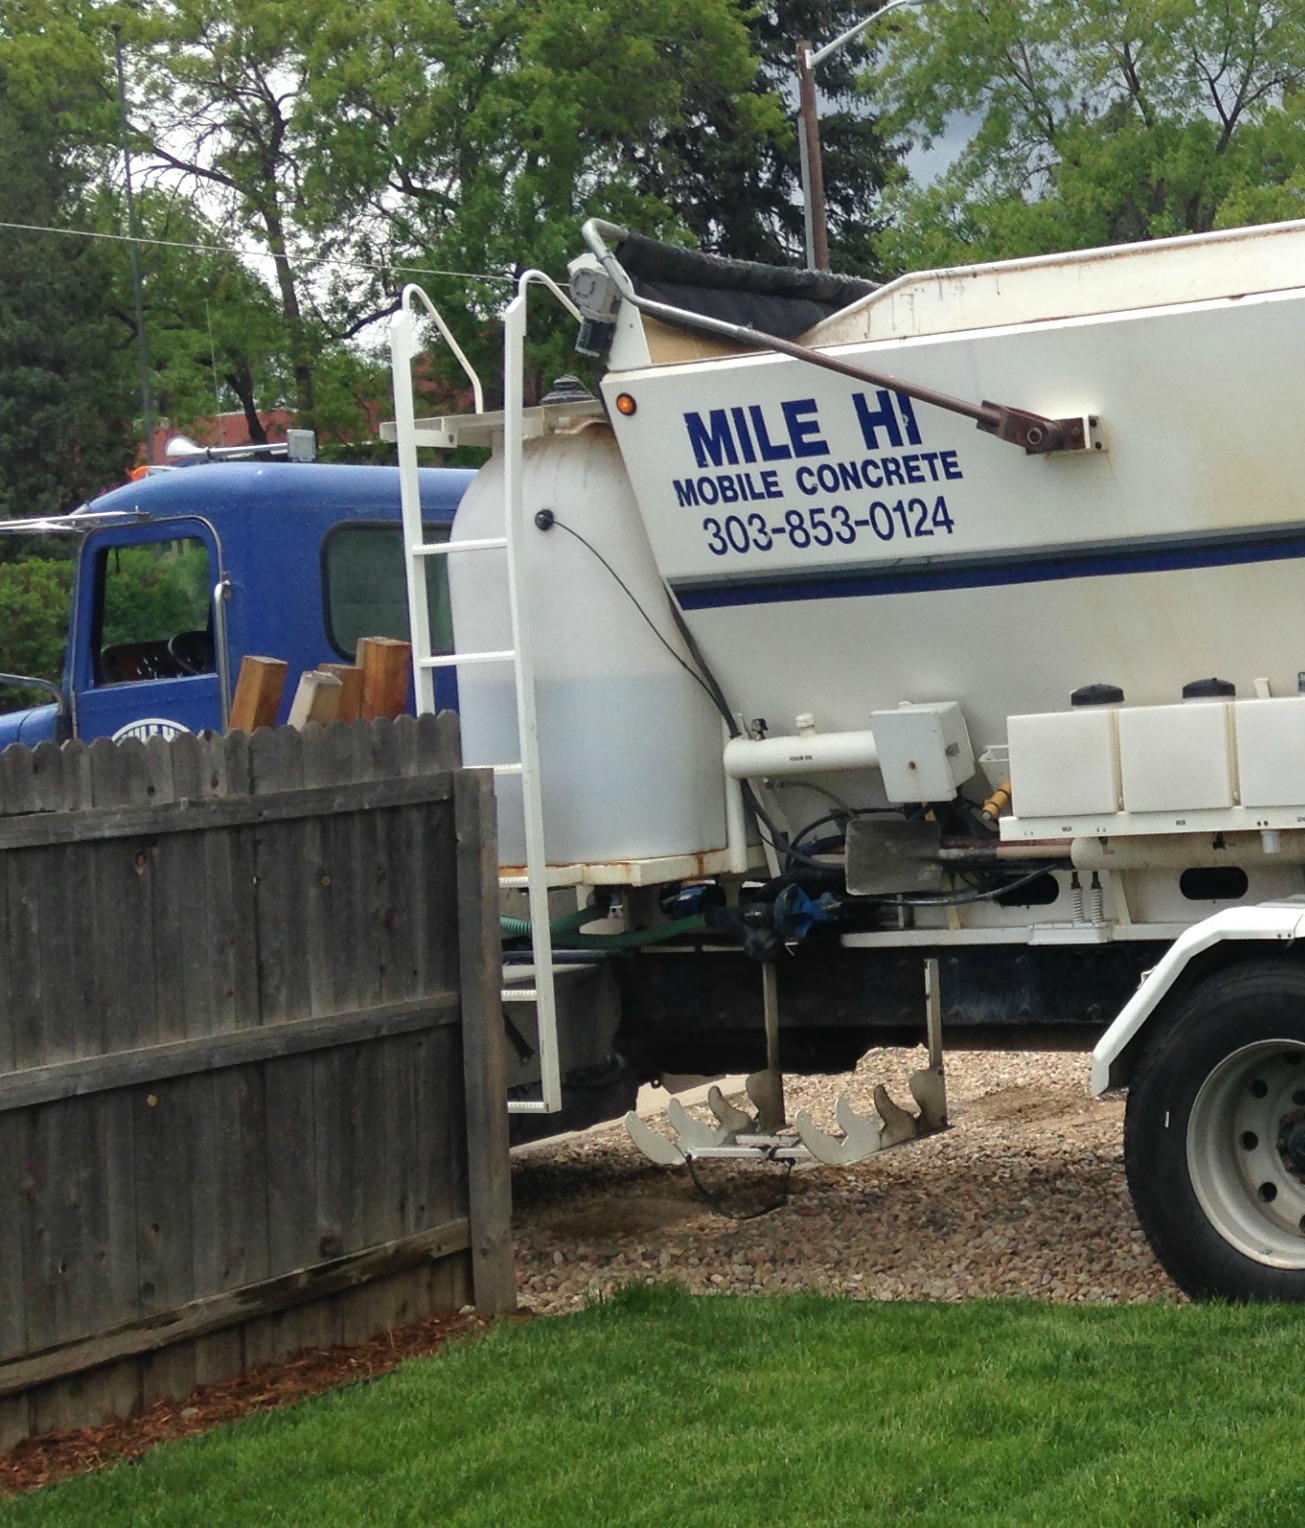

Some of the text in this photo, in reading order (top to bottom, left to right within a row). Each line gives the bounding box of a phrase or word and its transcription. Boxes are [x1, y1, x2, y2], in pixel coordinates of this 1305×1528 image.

[683, 389, 923, 469] MILE HI
[672, 450, 964, 507] MOBILE CONCRETE
[702, 496, 955, 556] 303-853-0124
